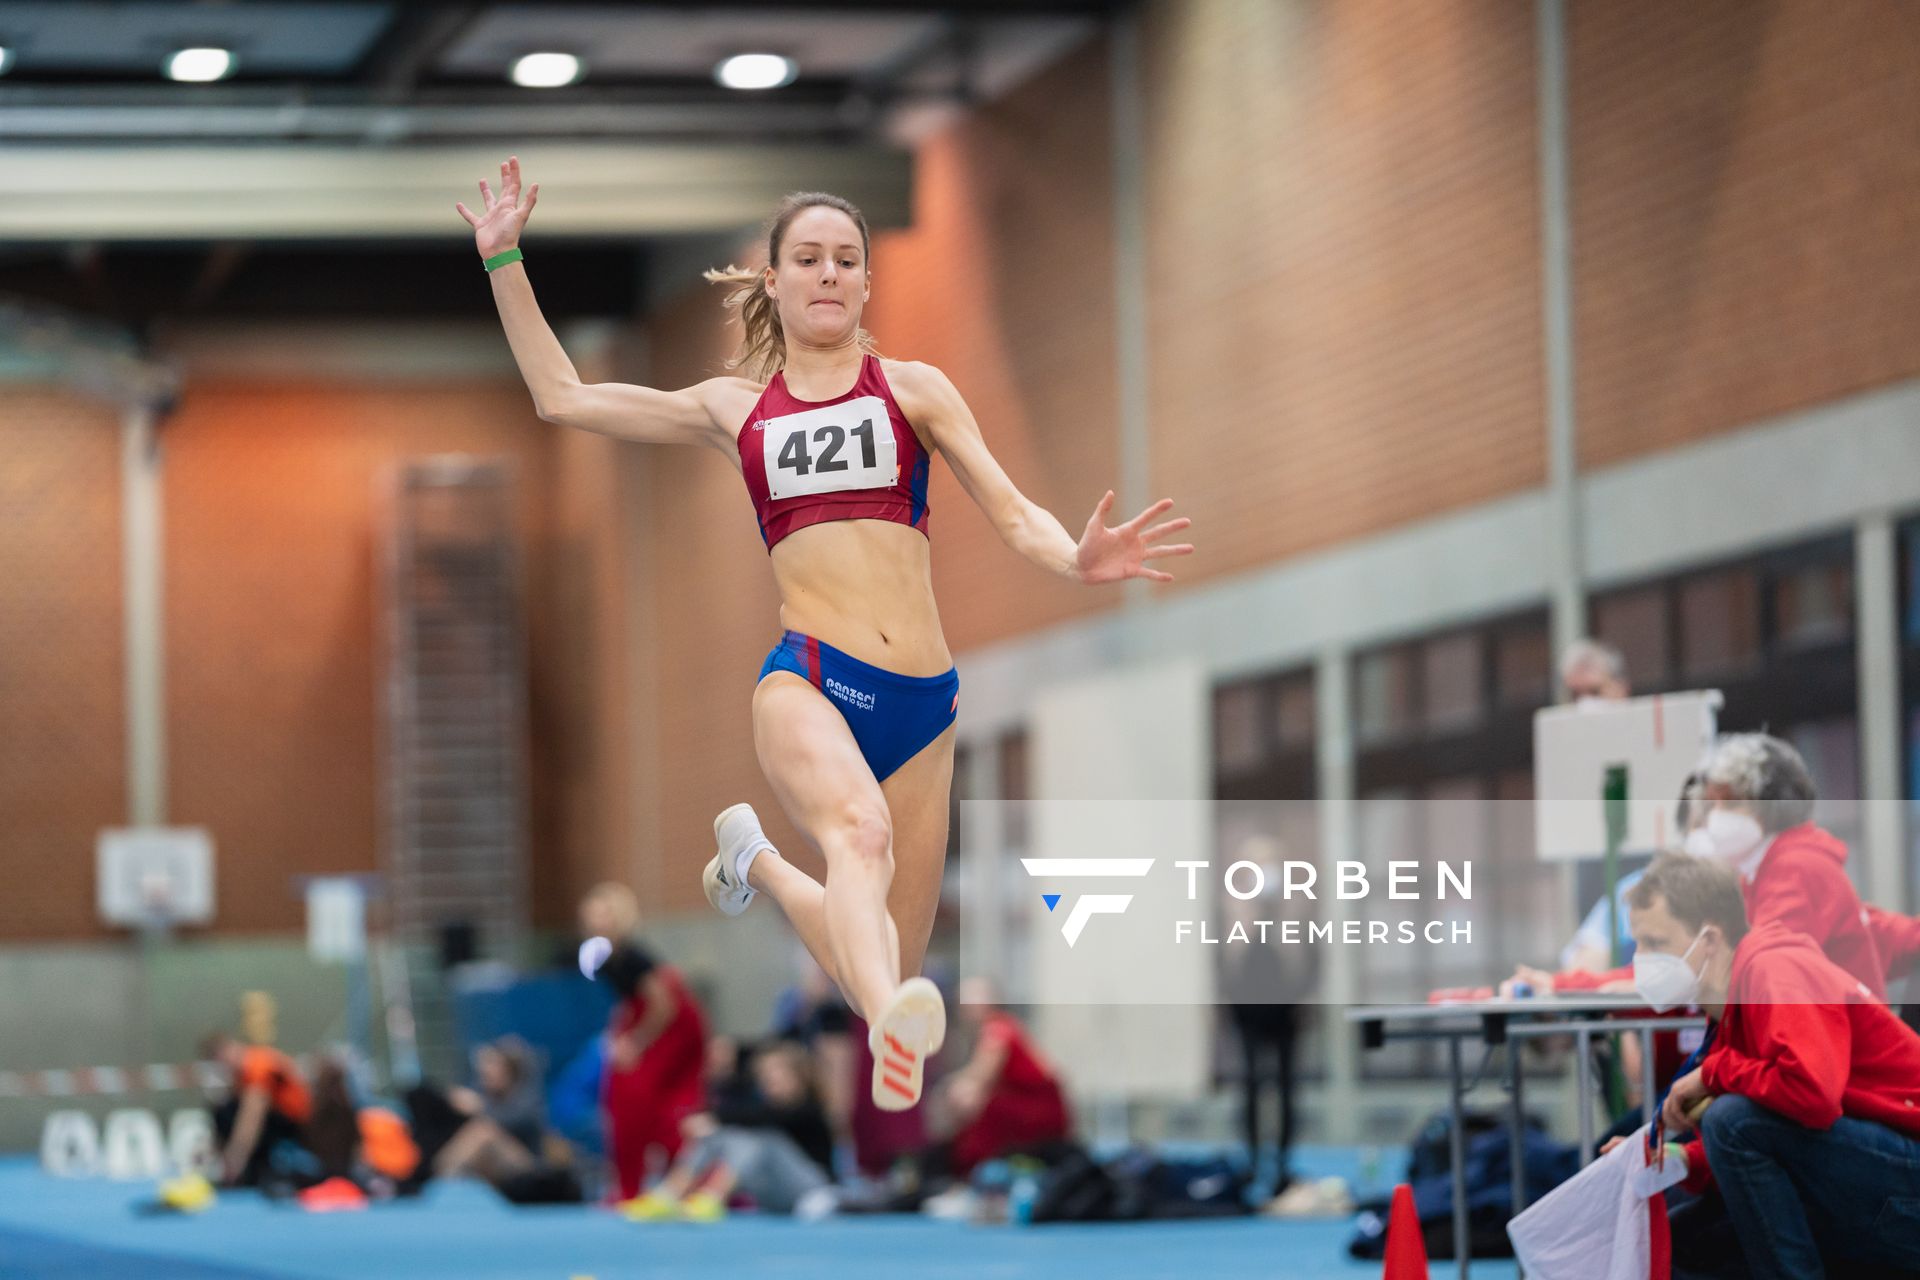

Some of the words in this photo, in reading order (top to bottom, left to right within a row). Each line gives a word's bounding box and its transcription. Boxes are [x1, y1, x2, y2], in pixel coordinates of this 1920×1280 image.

[777, 418, 877, 476] 421
[826, 678, 875, 705] panzeri
[830, 688, 848, 701] veste
[856, 700, 874, 712] sport
